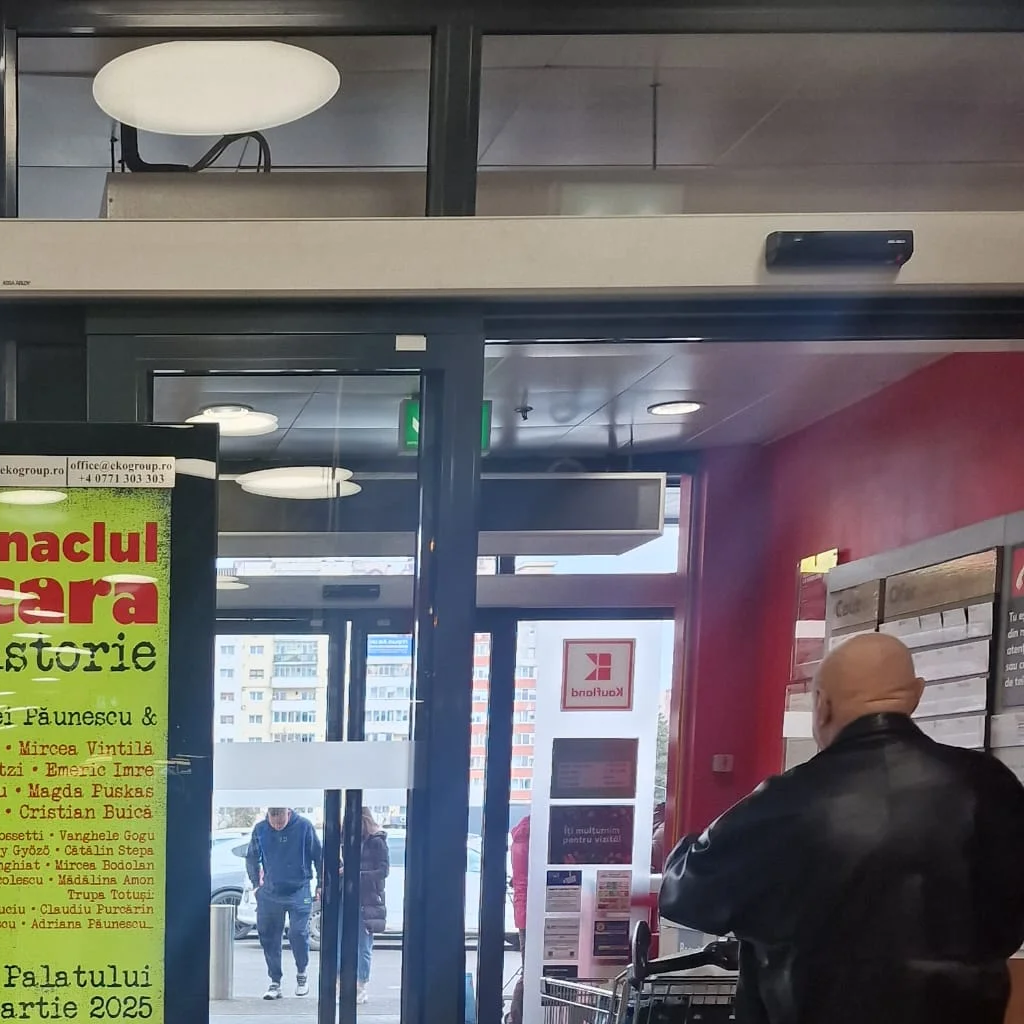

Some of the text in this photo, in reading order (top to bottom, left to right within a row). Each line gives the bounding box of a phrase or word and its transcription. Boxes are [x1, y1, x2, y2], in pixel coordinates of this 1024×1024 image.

[0, 465, 64, 477] ekogroup.ro
[70, 461, 172, 473] office@ekogroup.ro
[79, 474, 165, 484] +4 0771 303 303
[23, 707, 132, 726] Păunescu
[142, 706, 157, 726] &
[19, 741, 78, 756] Mircea
[86, 741, 154, 756] Vintilă
[45, 762, 106, 777] Emeric
[113, 762, 154, 778] Imre
[28, 783, 84, 801] Magda
[91, 783, 154, 799] Puskas
[20, 804, 96, 819] Cristian
[102, 804, 152, 819] Buică
[59, 830, 119, 843] Vanghele
[124, 830, 155, 843] Gogu
[65, 845, 114, 856] Cătălin
[118, 845, 154, 857] Stepa
[55, 860, 97, 870] Mircea
[102, 860, 154, 871] Bodolan
[58, 874, 117, 885] Mădălina
[123, 875, 154, 885] Amon
[67, 889, 106, 902] Trupa
[40, 904, 91, 914] Claudiu
[96, 904, 154, 914] Purcărin
[31, 919, 82, 929] Adriana
[4, 965, 152, 987] Palatului
[90, 996, 152, 1019] 2025
